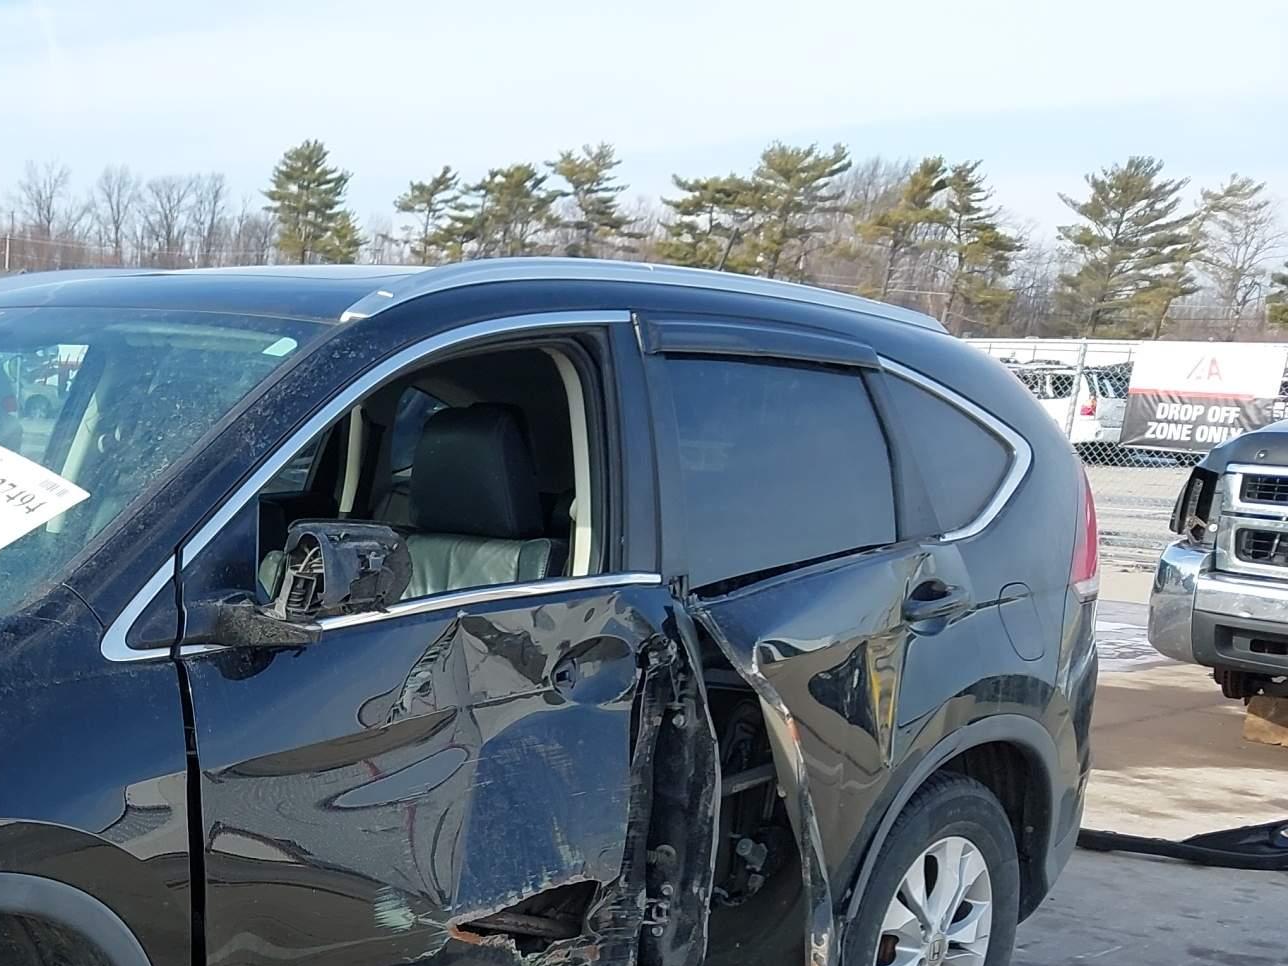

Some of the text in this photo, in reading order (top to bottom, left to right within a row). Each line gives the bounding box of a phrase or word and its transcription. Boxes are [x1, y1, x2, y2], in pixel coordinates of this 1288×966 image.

[1155, 402, 1242, 424] DROP OFF
[1144, 421, 1193, 441] ZONE
